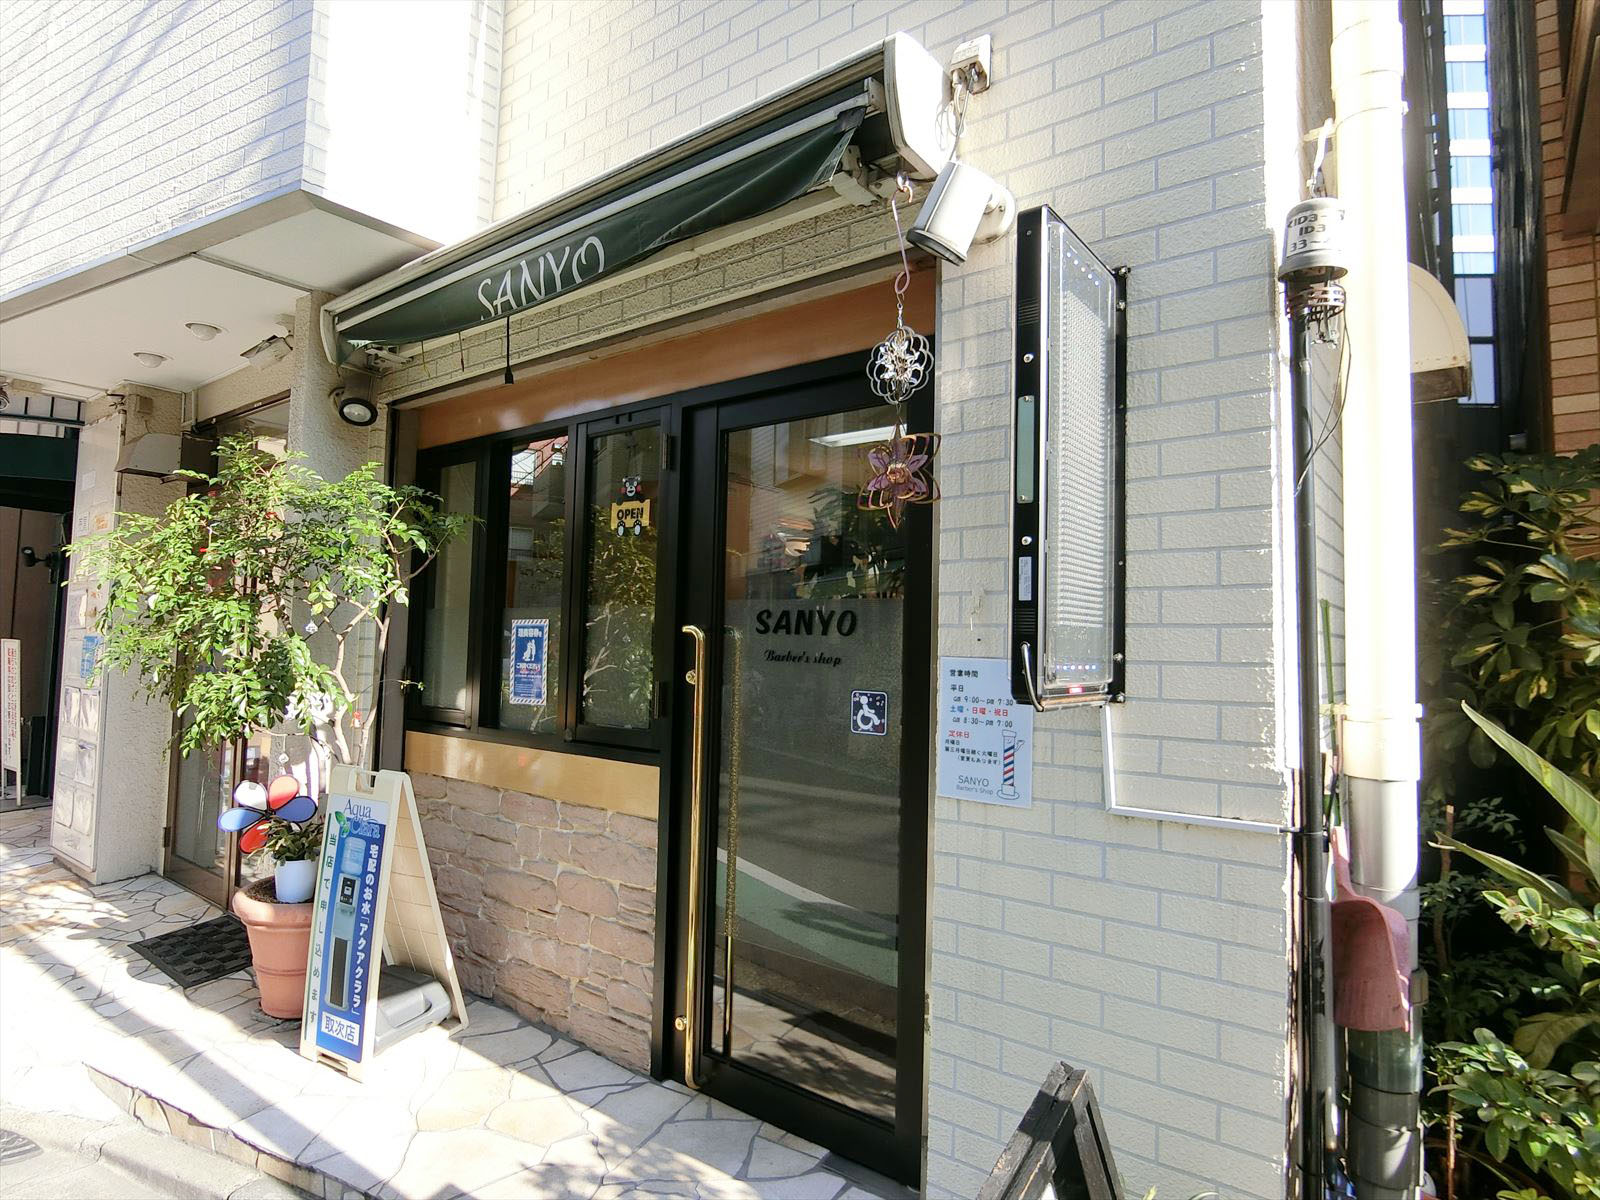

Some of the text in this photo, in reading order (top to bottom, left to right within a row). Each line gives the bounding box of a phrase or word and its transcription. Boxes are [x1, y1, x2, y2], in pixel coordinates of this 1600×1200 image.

[478, 236, 605, 320] SANYO
[617, 507, 644, 520] OPEN
[755, 609, 857, 637] SANYO
[763, 649, 843, 667] Barber's shop
[949, 669, 979, 678] 営業時間
[950, 684, 964, 692] 平日
[997, 698, 1014, 706] 7:30
[997, 720, 1013, 728] 7:00
[948, 730, 970, 738] 定休日
[958, 775, 989, 787] SANYO
[979, 787, 994, 795] Shop
[343, 798, 372, 820] Aqua
[351, 844, 379, 1016] 宅配のお水「アクアクララ」
[325, 1015, 356, 1042] 取次店
